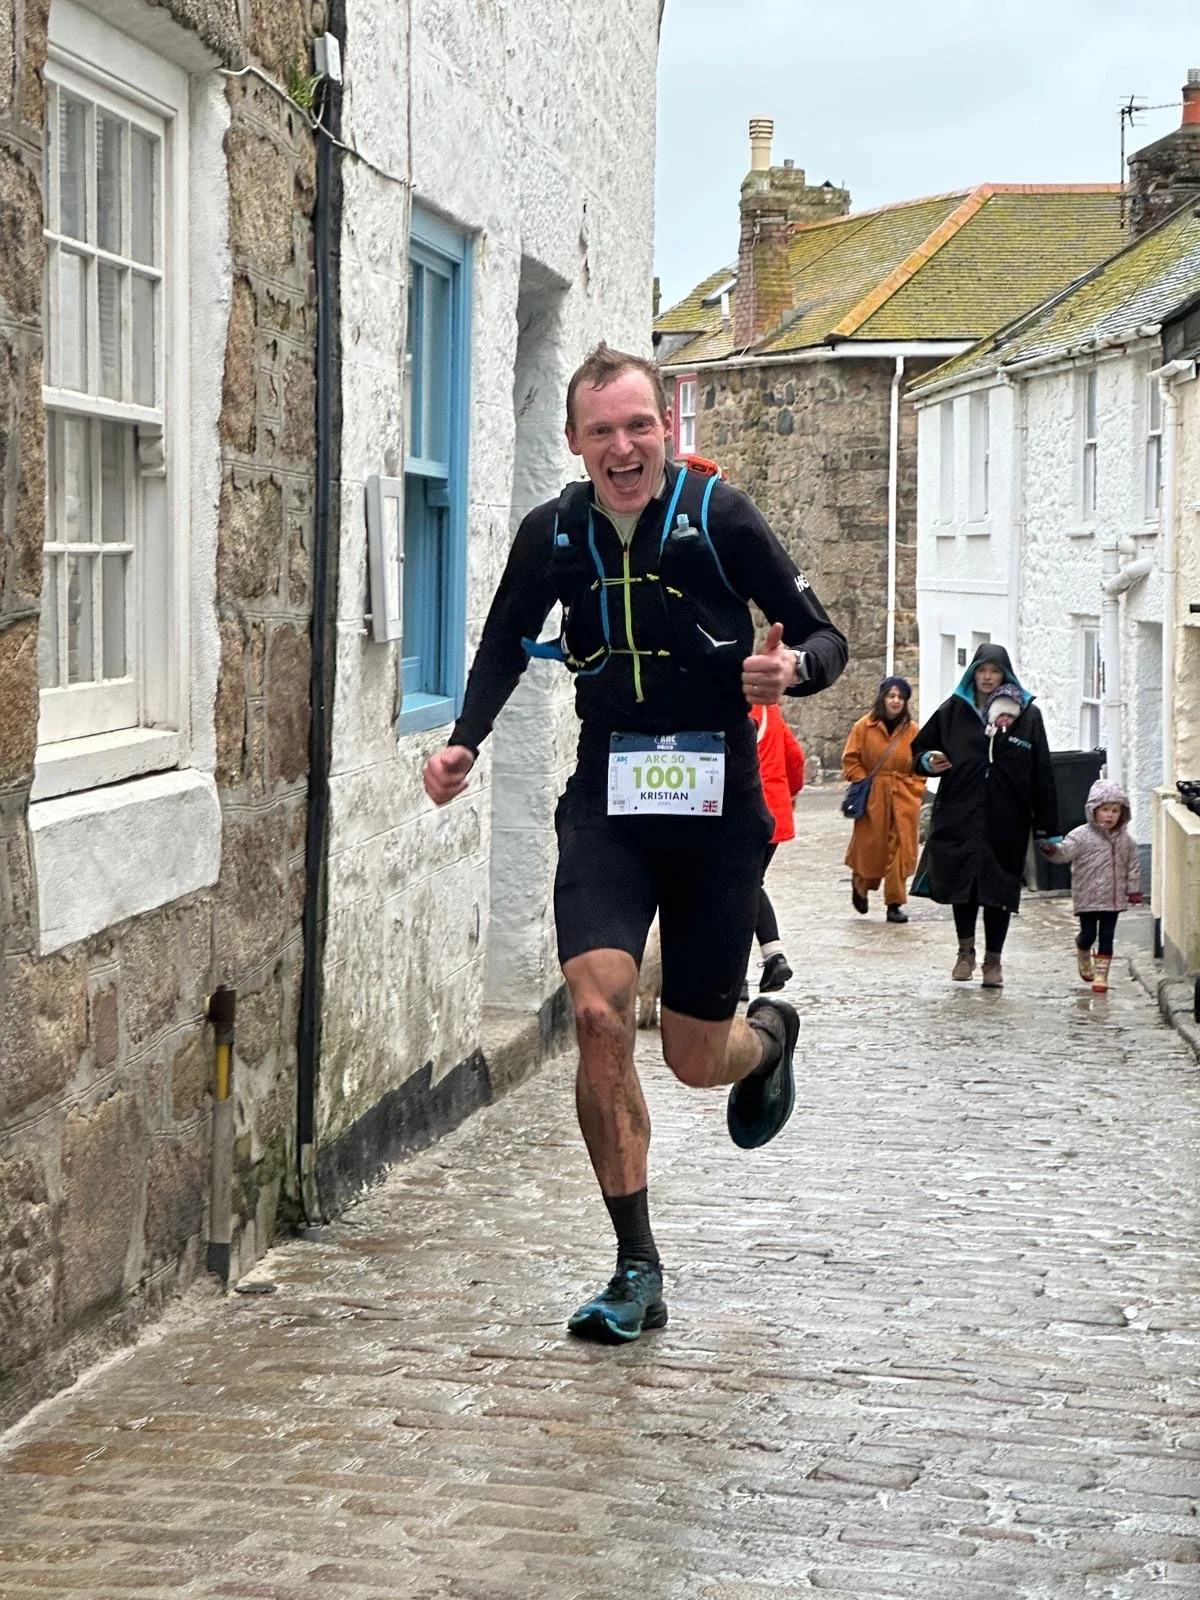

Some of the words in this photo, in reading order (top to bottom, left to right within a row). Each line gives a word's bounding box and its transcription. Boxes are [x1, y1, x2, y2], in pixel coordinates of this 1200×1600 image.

[645, 754, 668, 764] ARC
[672, 754, 685, 764] 50
[632, 766, 697, 790] 1001
[640, 791, 689, 800] KRISTIAN
